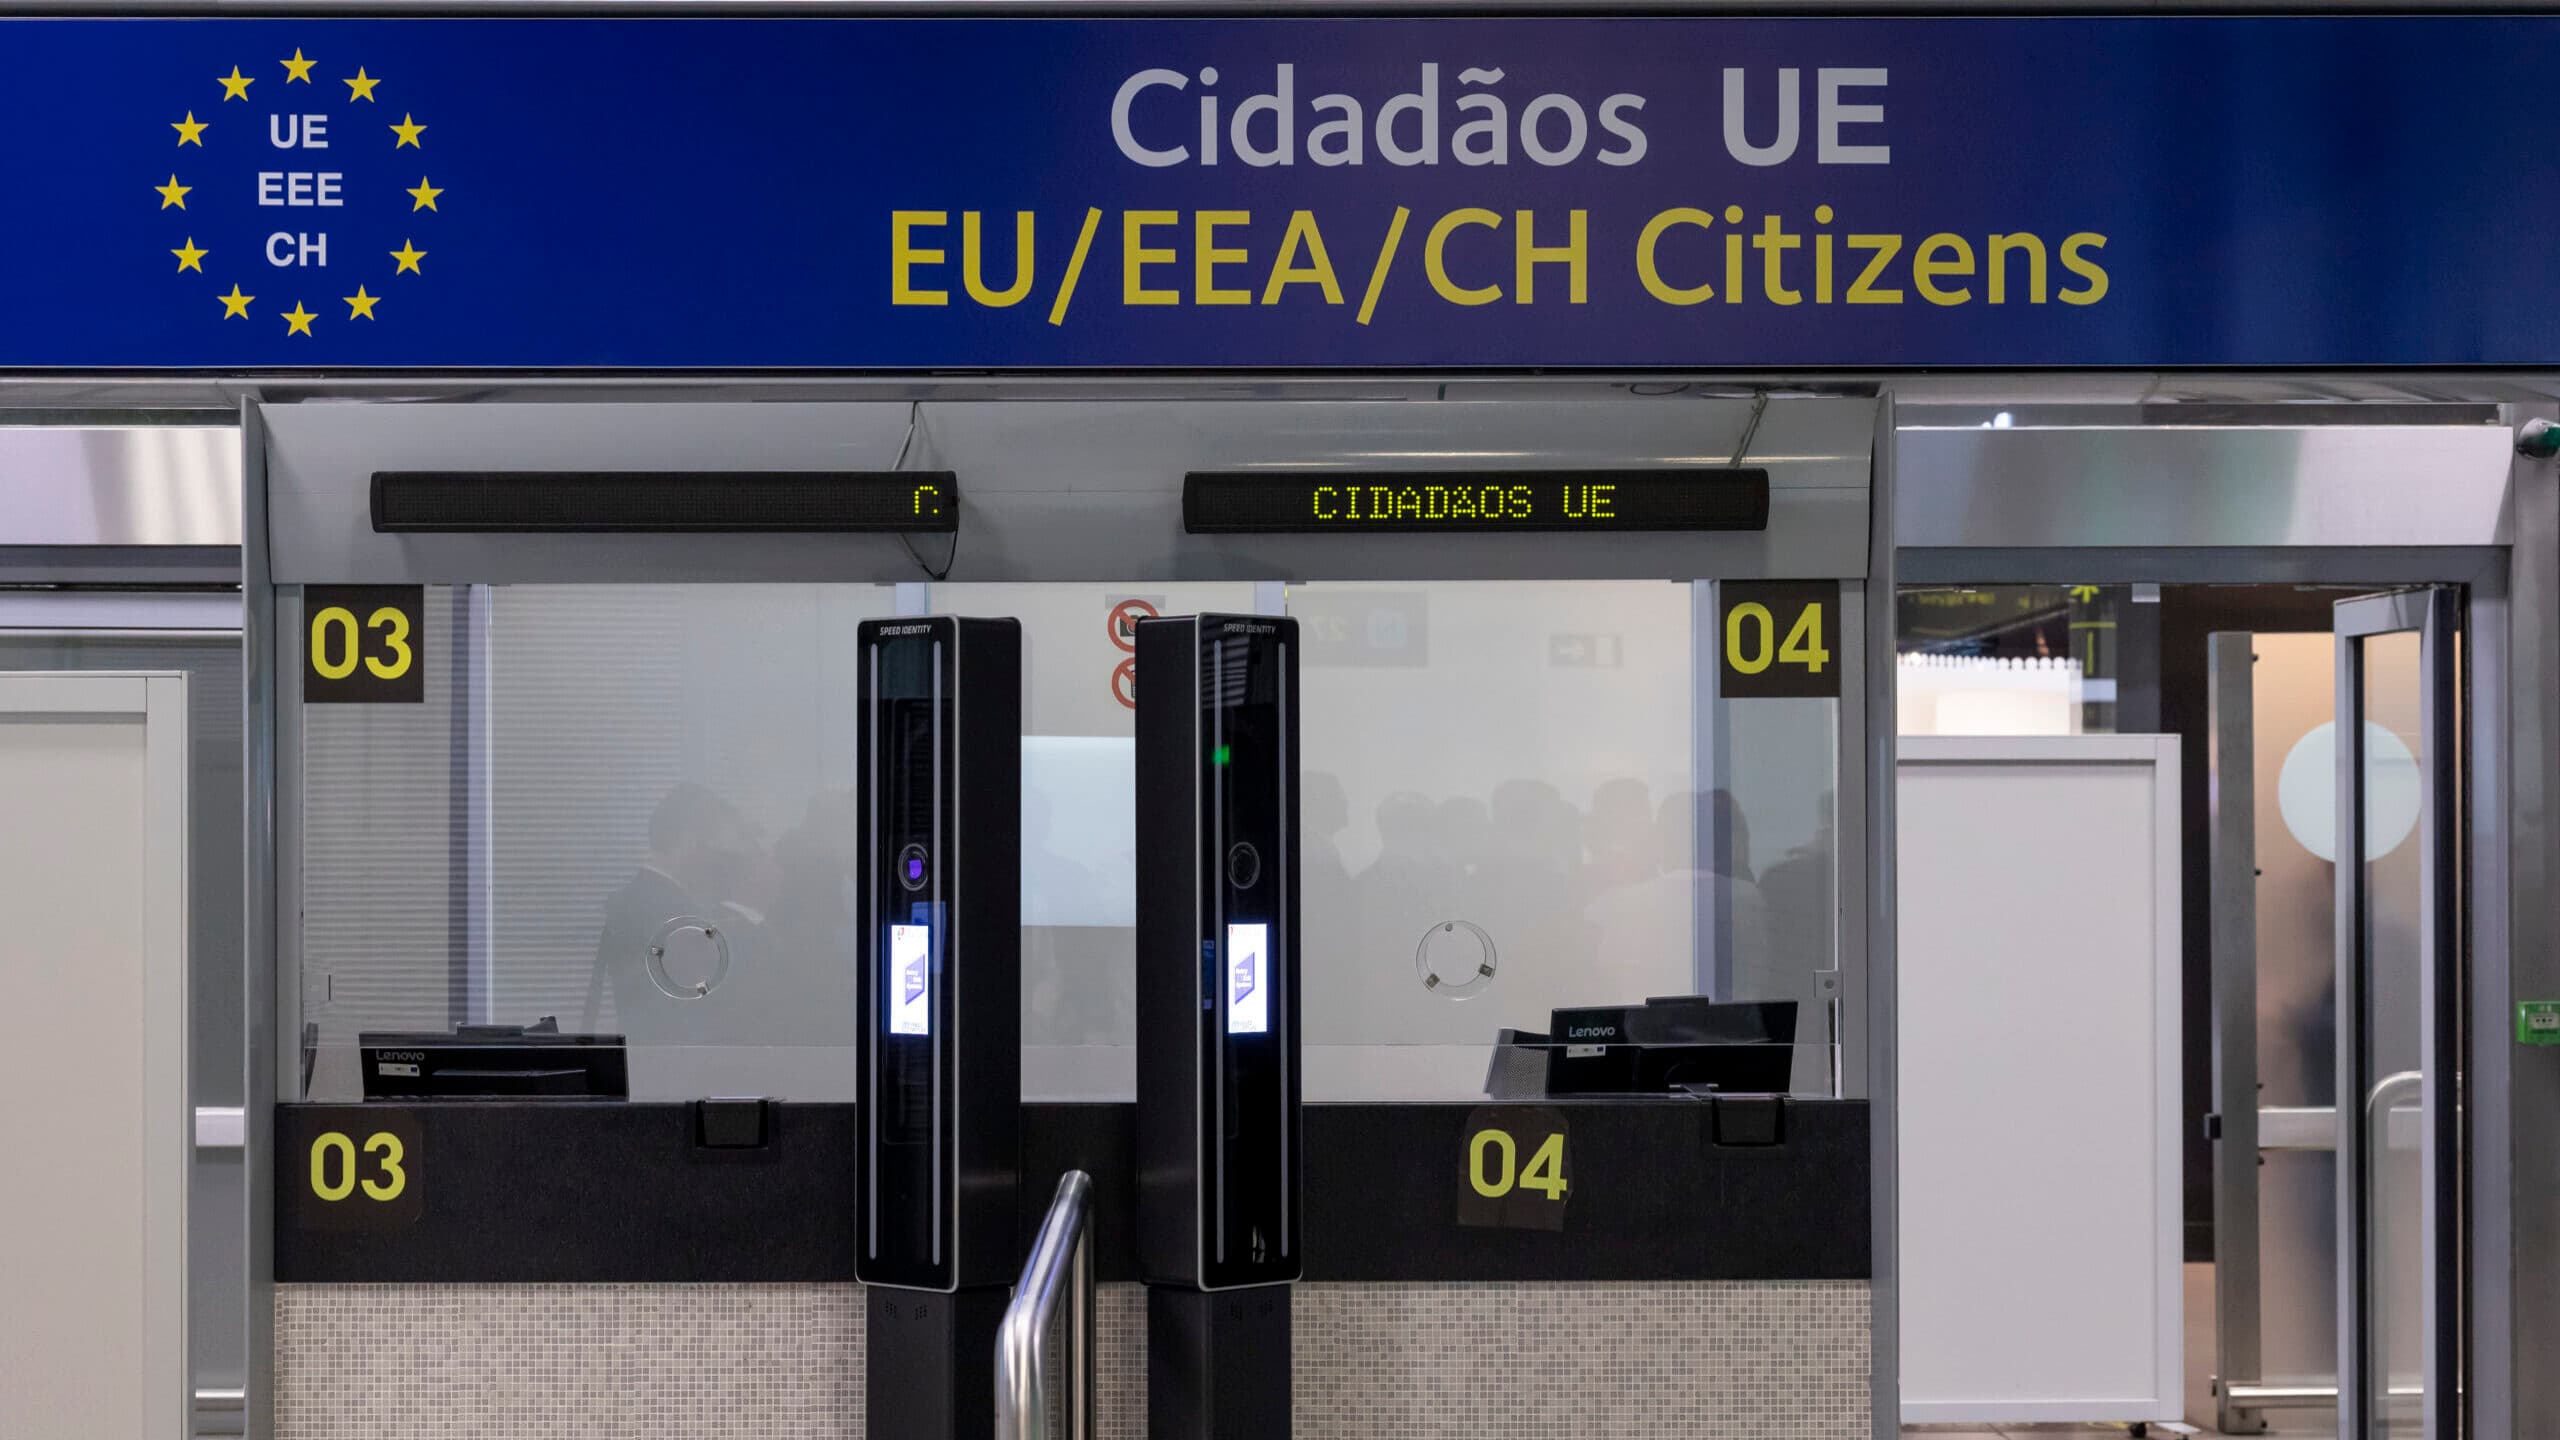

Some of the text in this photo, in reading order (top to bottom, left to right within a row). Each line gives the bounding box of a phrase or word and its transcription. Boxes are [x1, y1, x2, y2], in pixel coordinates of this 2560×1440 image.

[270, 114, 329, 149] UE
[1111, 62, 1890, 168] Cidadãos UE
[258, 172, 344, 206] EEE
[265, 232, 327, 267] CH
[892, 205, 2109, 326] EU/EEA/CH Citizens
[1563, 484, 1616, 518] UE
[311, 606, 412, 680] 03
[879, 624, 932, 636] SPEED IDENTITY
[1223, 623, 1277, 634] SPEED IDENTITY
[1726, 602, 1829, 675] 04
[1568, 1025, 1616, 1038] Lenovo
[375, 1049, 425, 1062] Lenovo
[310, 1131, 406, 1202] 03
[1469, 1128, 1568, 1201] 04
